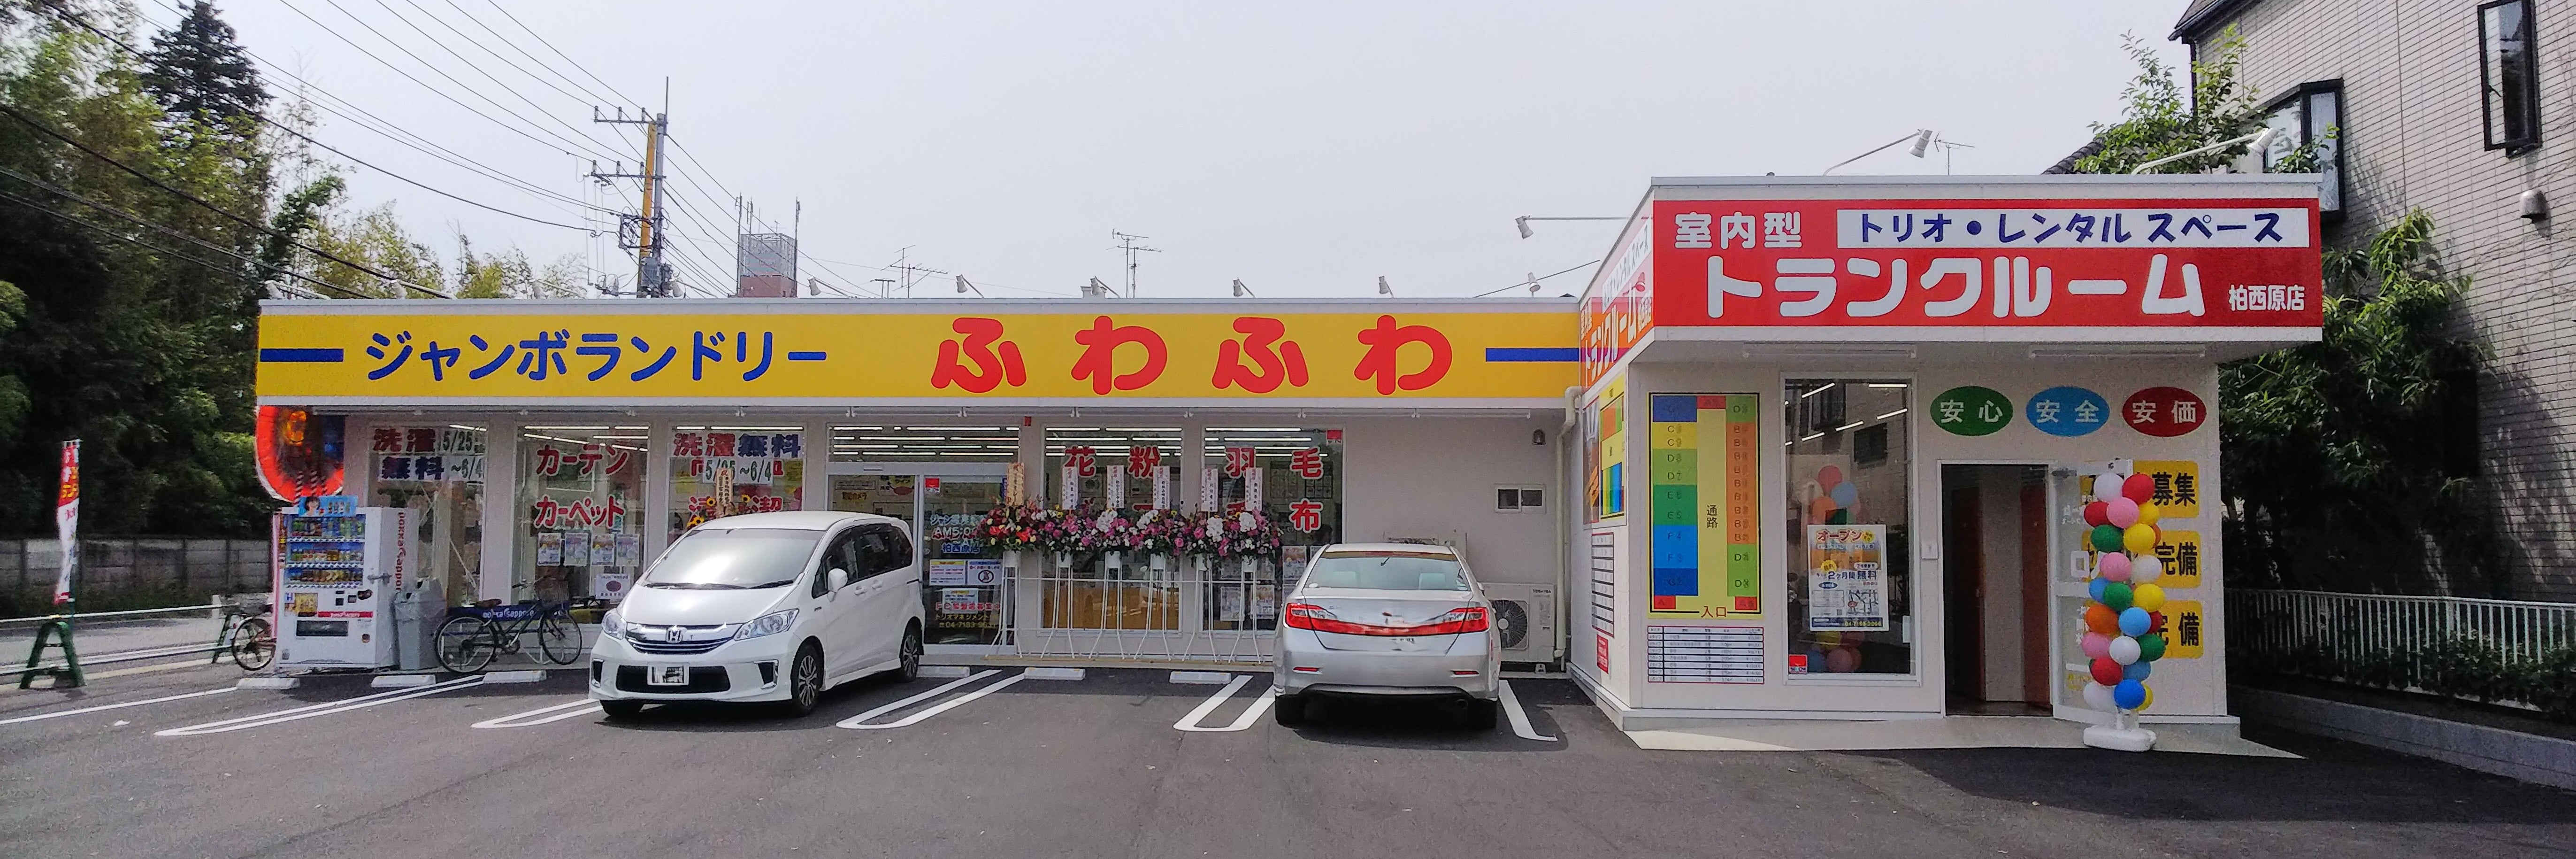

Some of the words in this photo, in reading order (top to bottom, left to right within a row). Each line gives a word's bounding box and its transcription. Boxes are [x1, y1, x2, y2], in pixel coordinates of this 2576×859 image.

[1674, 211, 1802, 249] 室内型
[2147, 213, 2283, 243] スペース
[1707, 254, 2205, 319] トランクルーム
[2228, 284, 2305, 312] 柏西原店
[366, 330, 827, 381] ジャンボランドリー
[930, 315, 1453, 395] ふわふわ
[1940, 400, 2003, 423] 安心
[2036, 400, 2099, 423] 安全
[2131, 400, 2196, 424] 安価
[537, 444, 627, 474] カーテン
[674, 433, 801, 458] 洗濯無料
[1065, 446, 1160, 478] 花粉
[1226, 447, 1322, 477] 羽毛
[536, 496, 624, 527] カーペット
[1706, 505, 1718, 528] 通路
[1817, 530, 1863, 542] オープン
[2155, 542, 2198, 575] 完備
[1701, 606, 1726, 618] 入口
